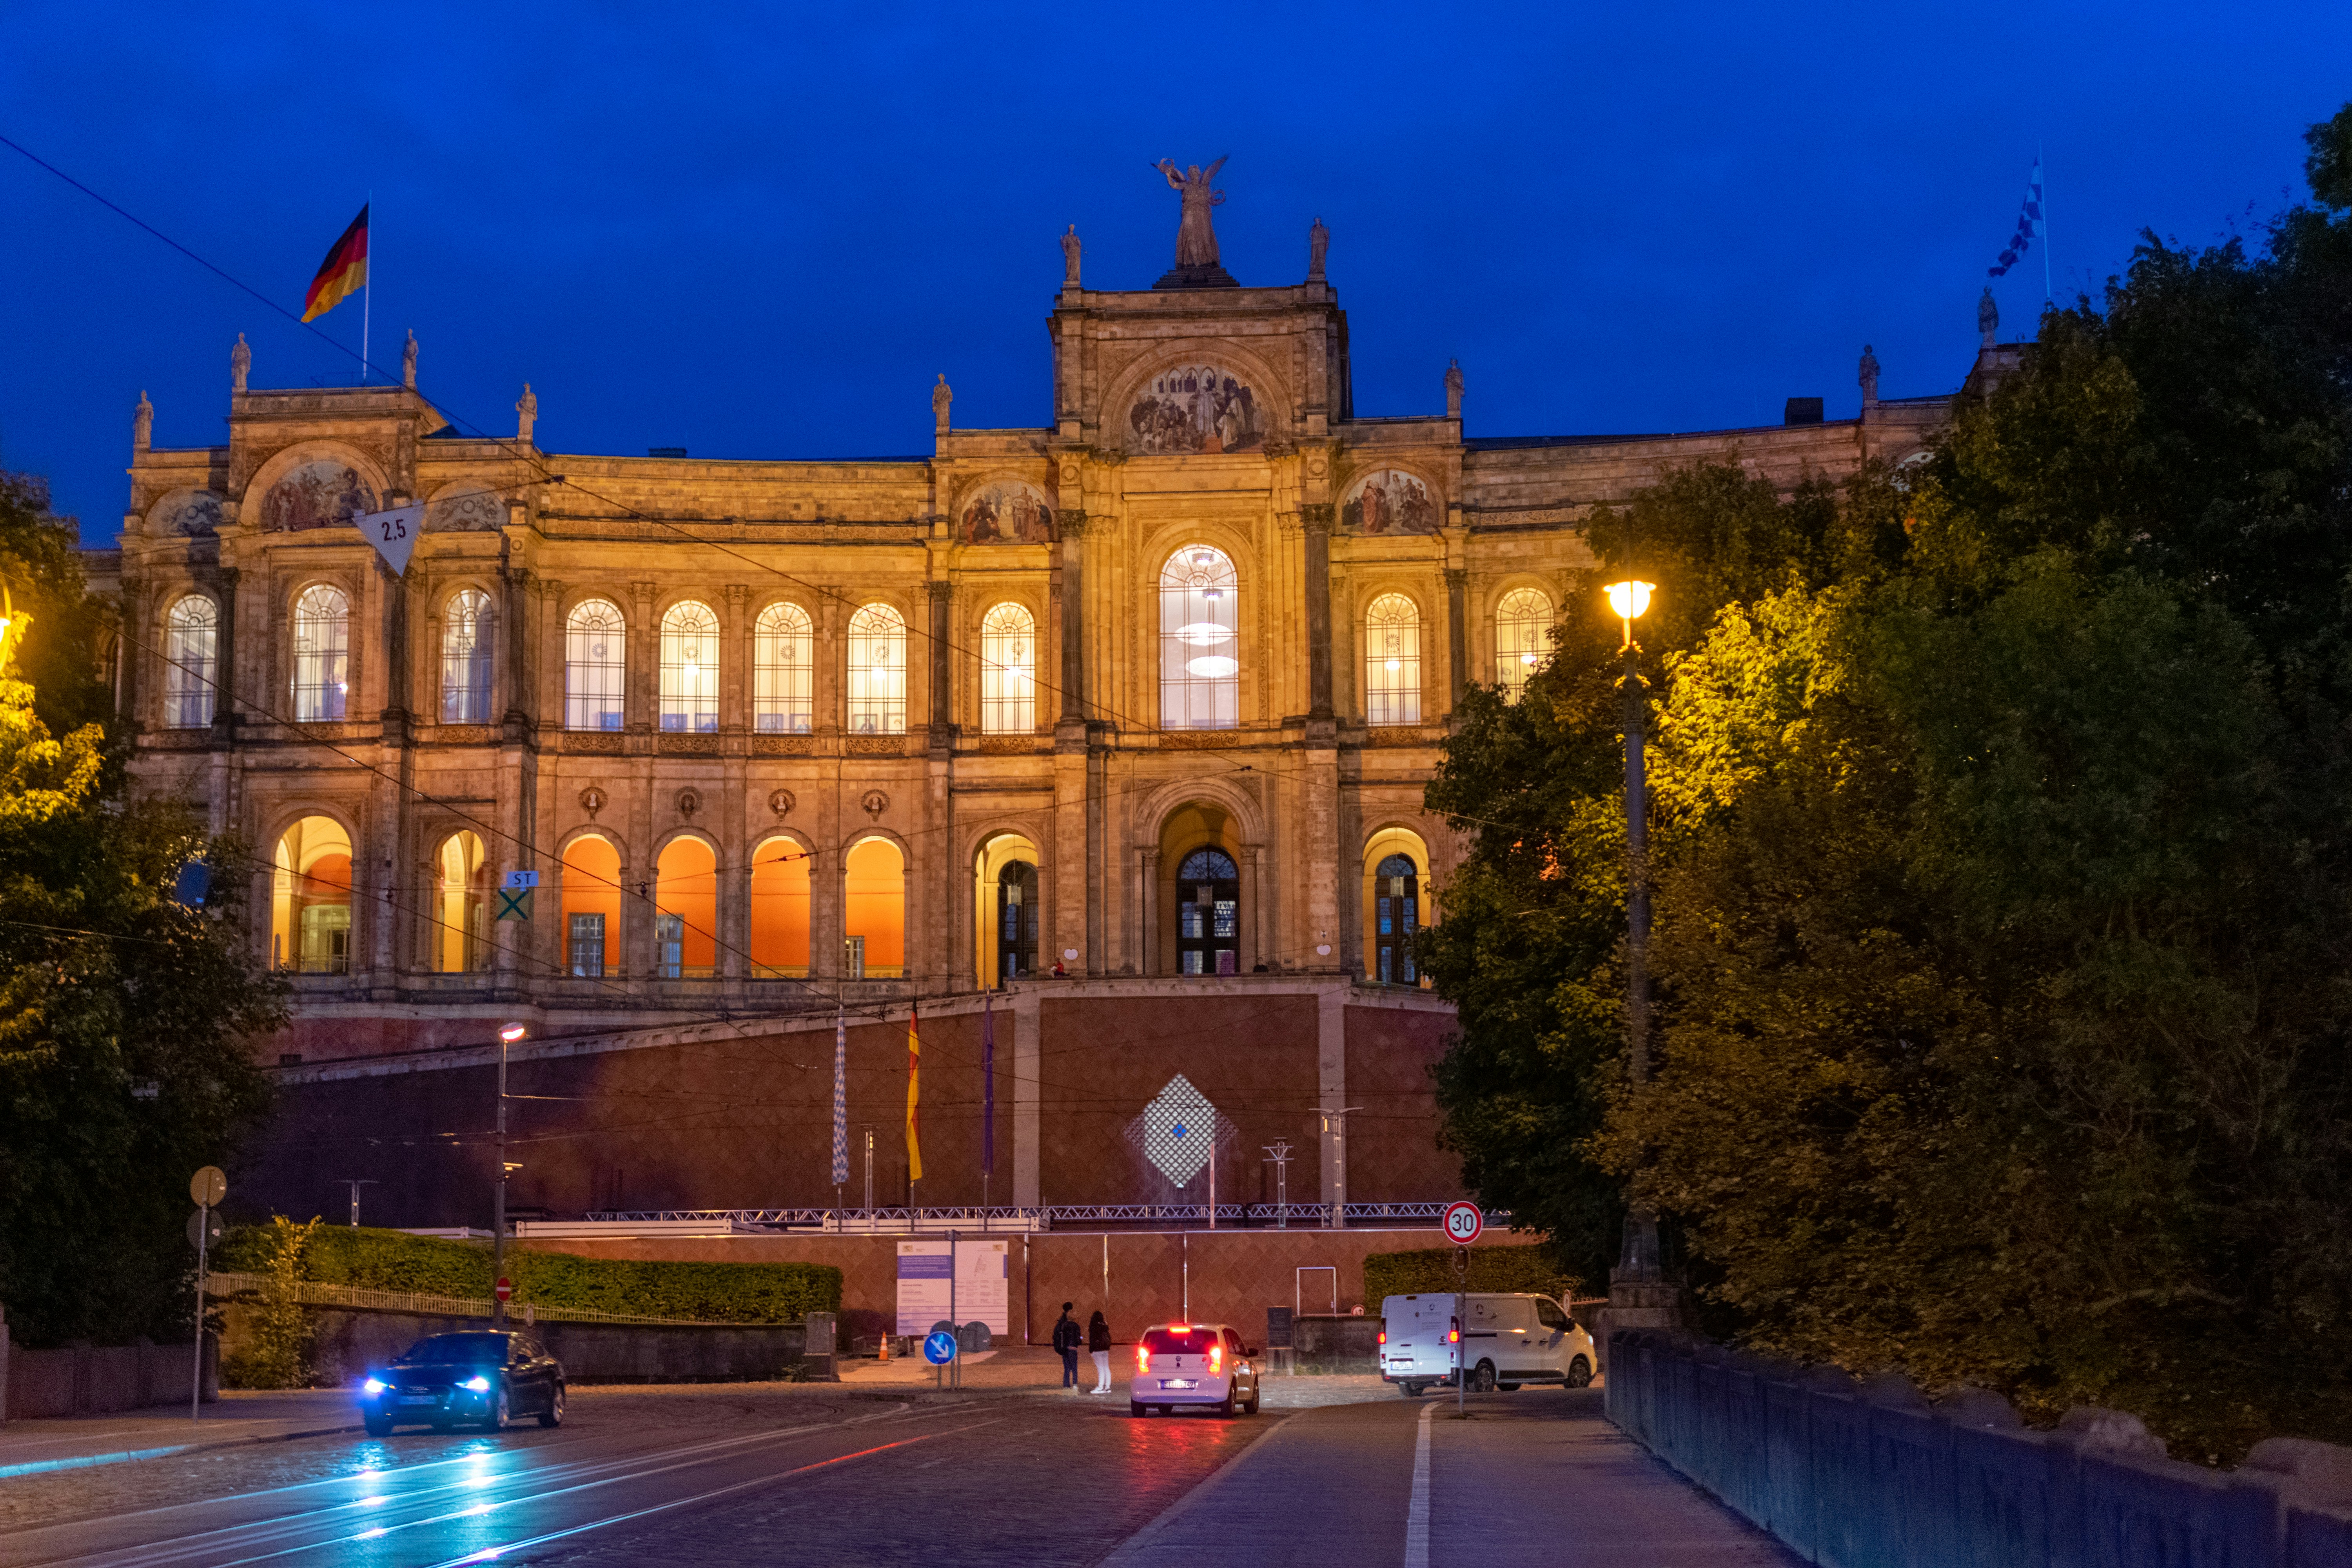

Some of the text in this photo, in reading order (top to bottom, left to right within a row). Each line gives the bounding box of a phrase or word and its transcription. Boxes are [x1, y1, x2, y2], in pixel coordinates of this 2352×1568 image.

[381, 519, 406, 541] 2.5
[514, 873, 531, 885] ST
[1452, 1214, 1473, 1232] 30
